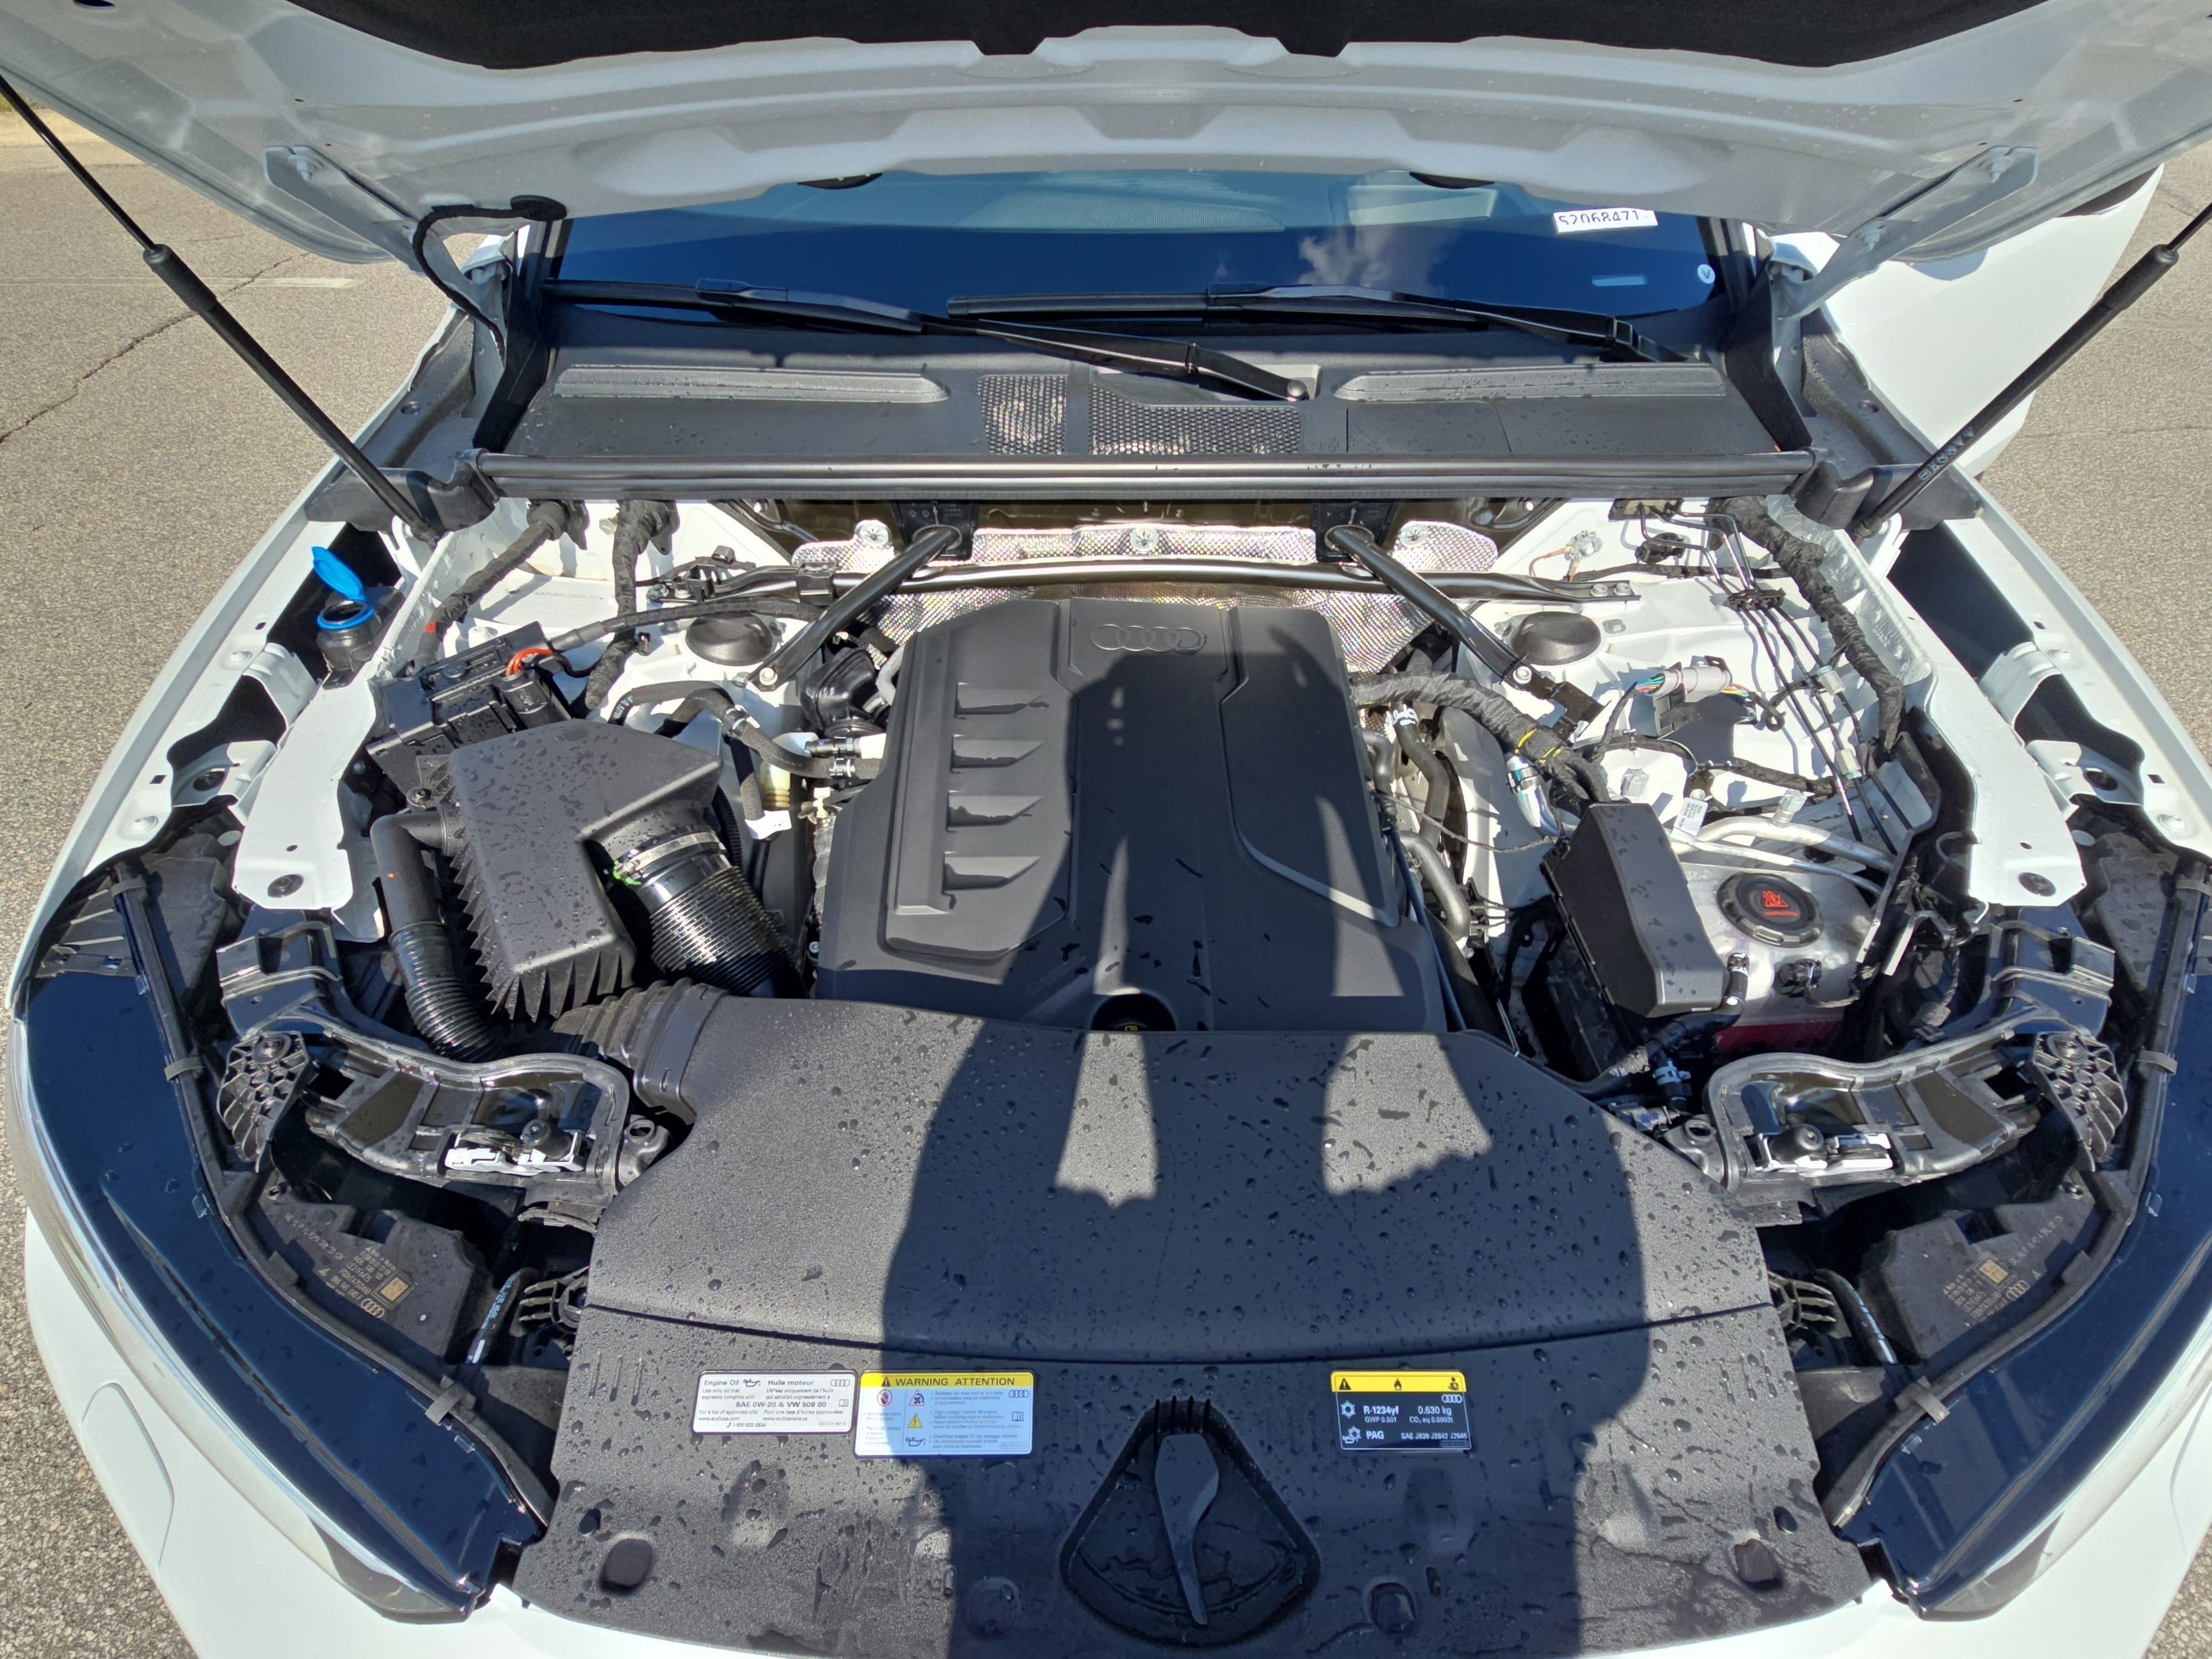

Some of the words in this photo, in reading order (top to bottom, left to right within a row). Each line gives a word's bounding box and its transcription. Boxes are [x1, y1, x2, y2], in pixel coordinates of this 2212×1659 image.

[1363, 1405, 1399, 1415] R-1234yf
[1418, 1406, 1440, 1415] 0.630
[1442, 1406, 1452, 1416] kg
[1366, 1431, 1384, 1439] PAG
